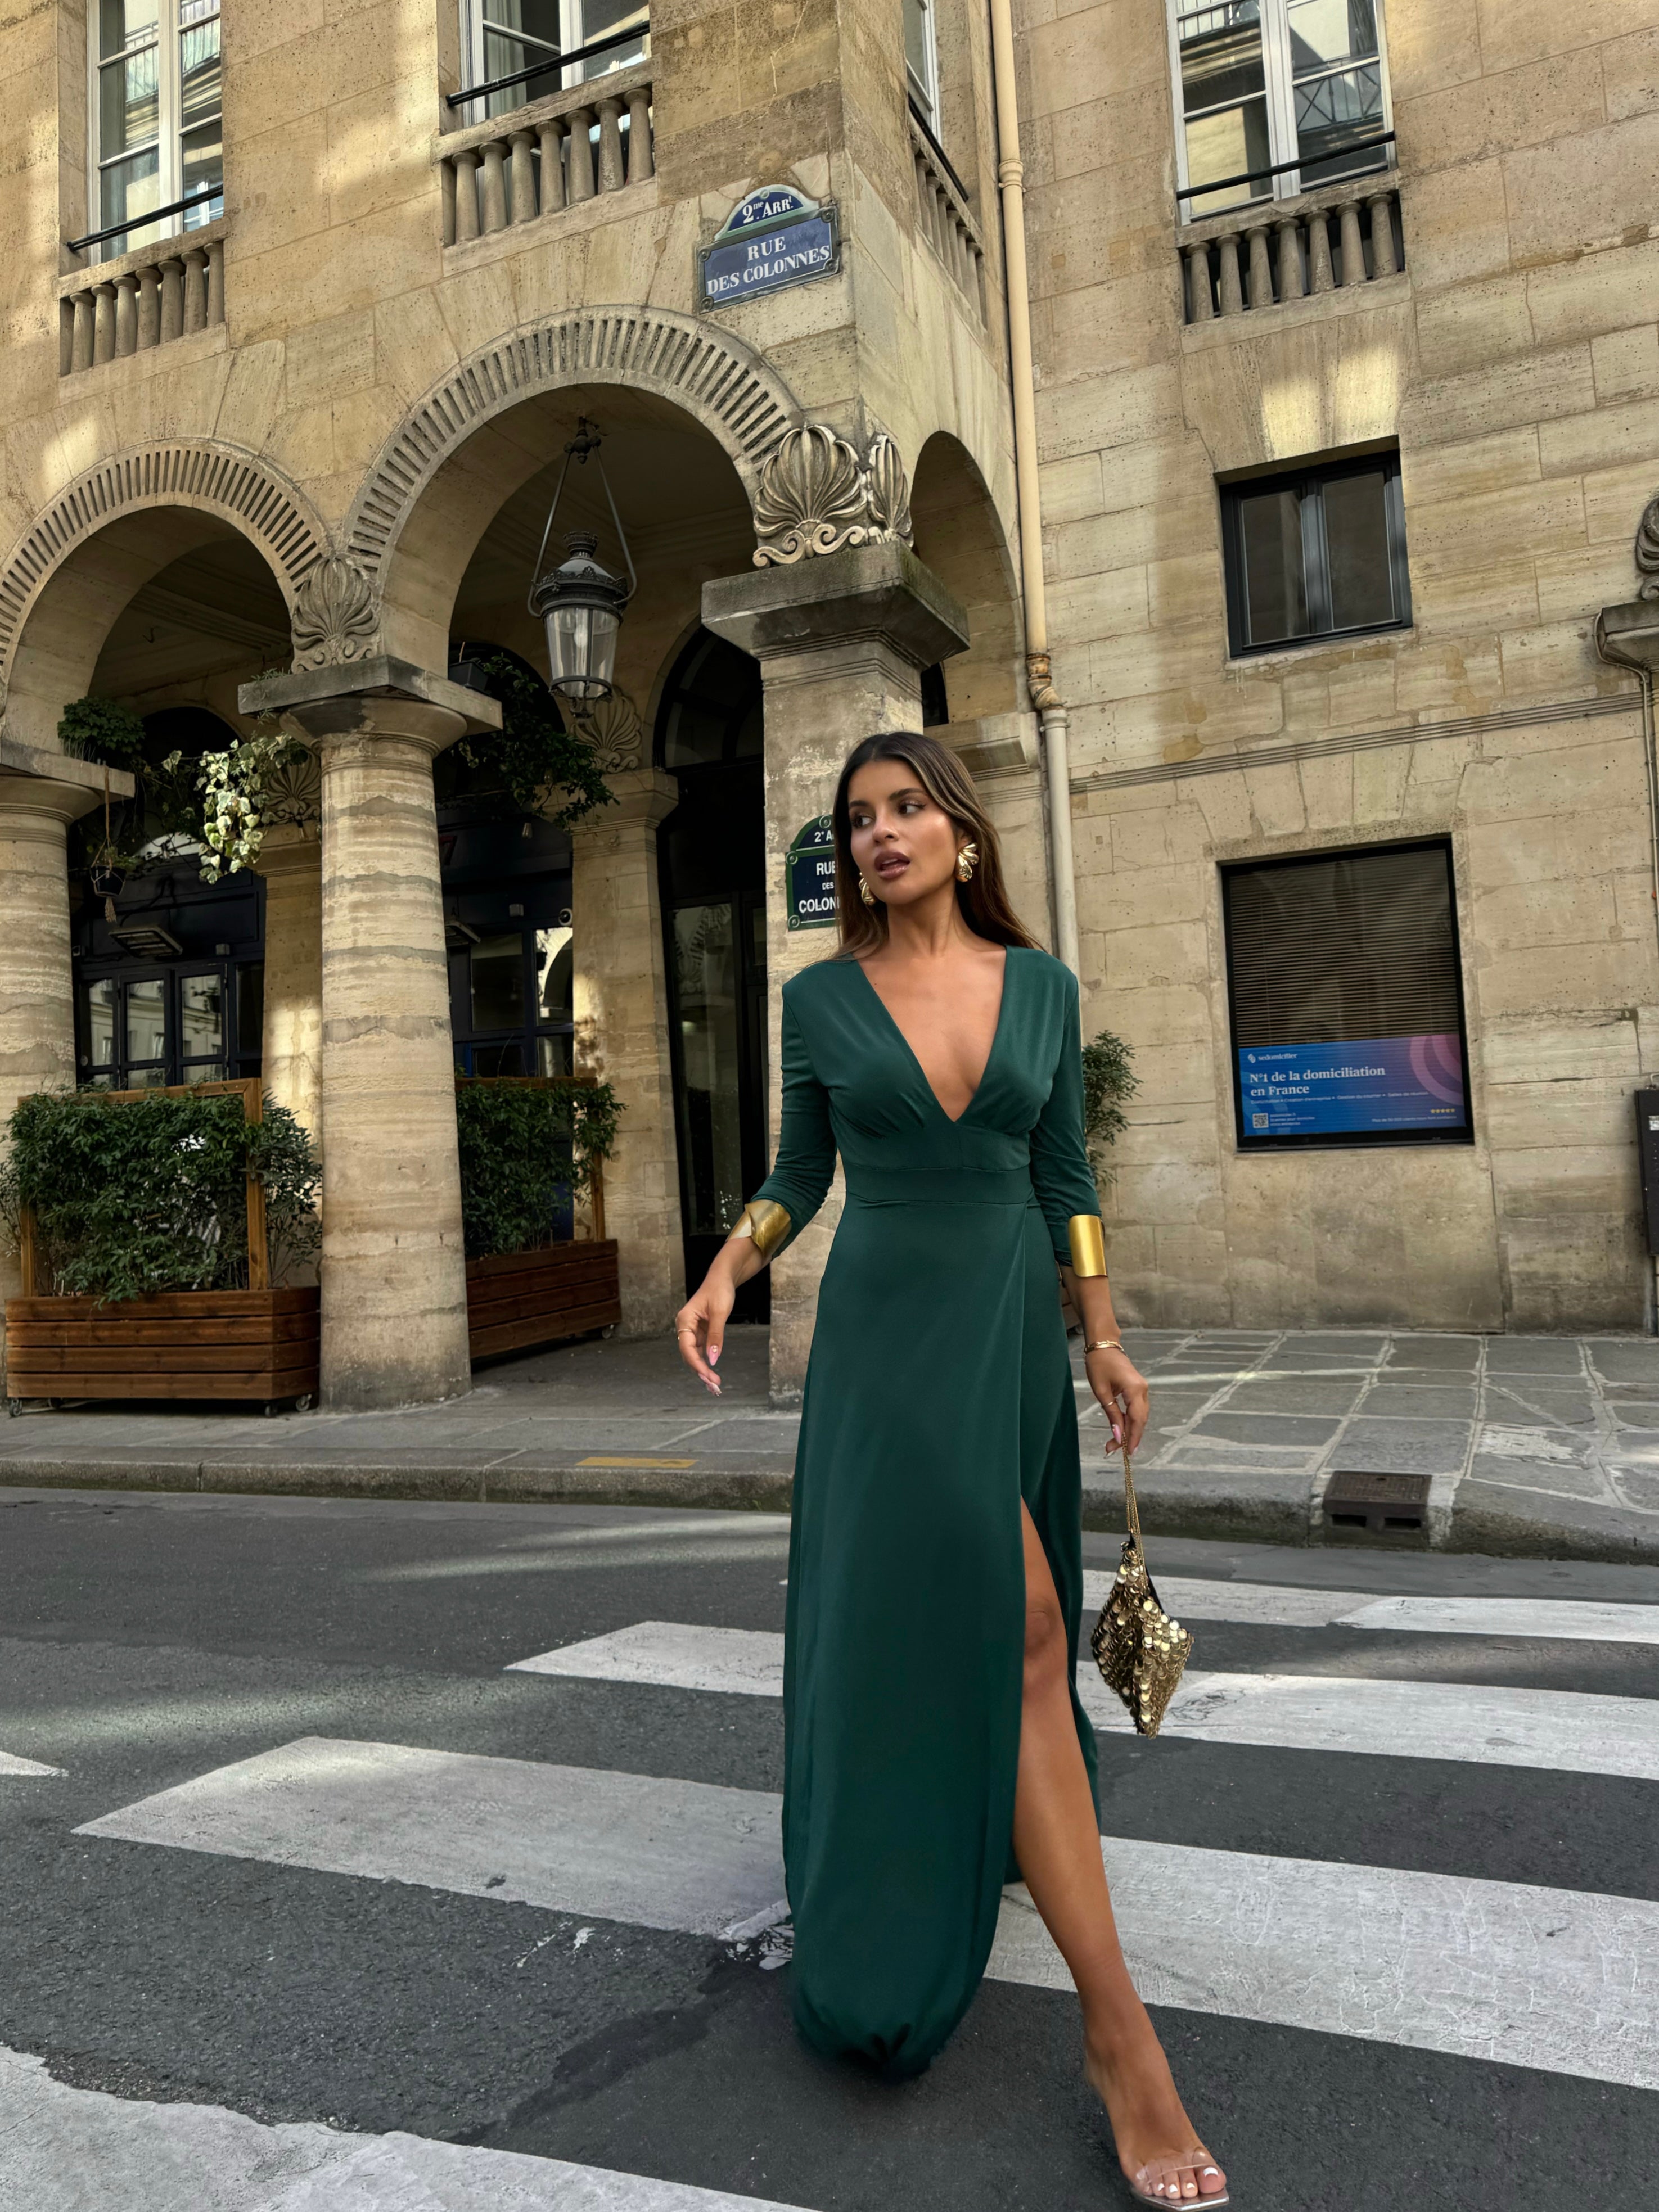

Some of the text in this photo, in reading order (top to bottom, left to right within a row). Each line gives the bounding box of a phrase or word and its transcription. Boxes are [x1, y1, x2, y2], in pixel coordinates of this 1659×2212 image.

[747, 236, 786, 261] RUE
[707, 245, 830, 295] DES COLONNES
[826, 830, 834, 841] A
[816, 860, 836, 876] RUE
[822, 881, 835, 890] DES
[1250, 1066, 1386, 1083] N°1 de la domiciliation
[1269, 1086, 1310, 1096] France
